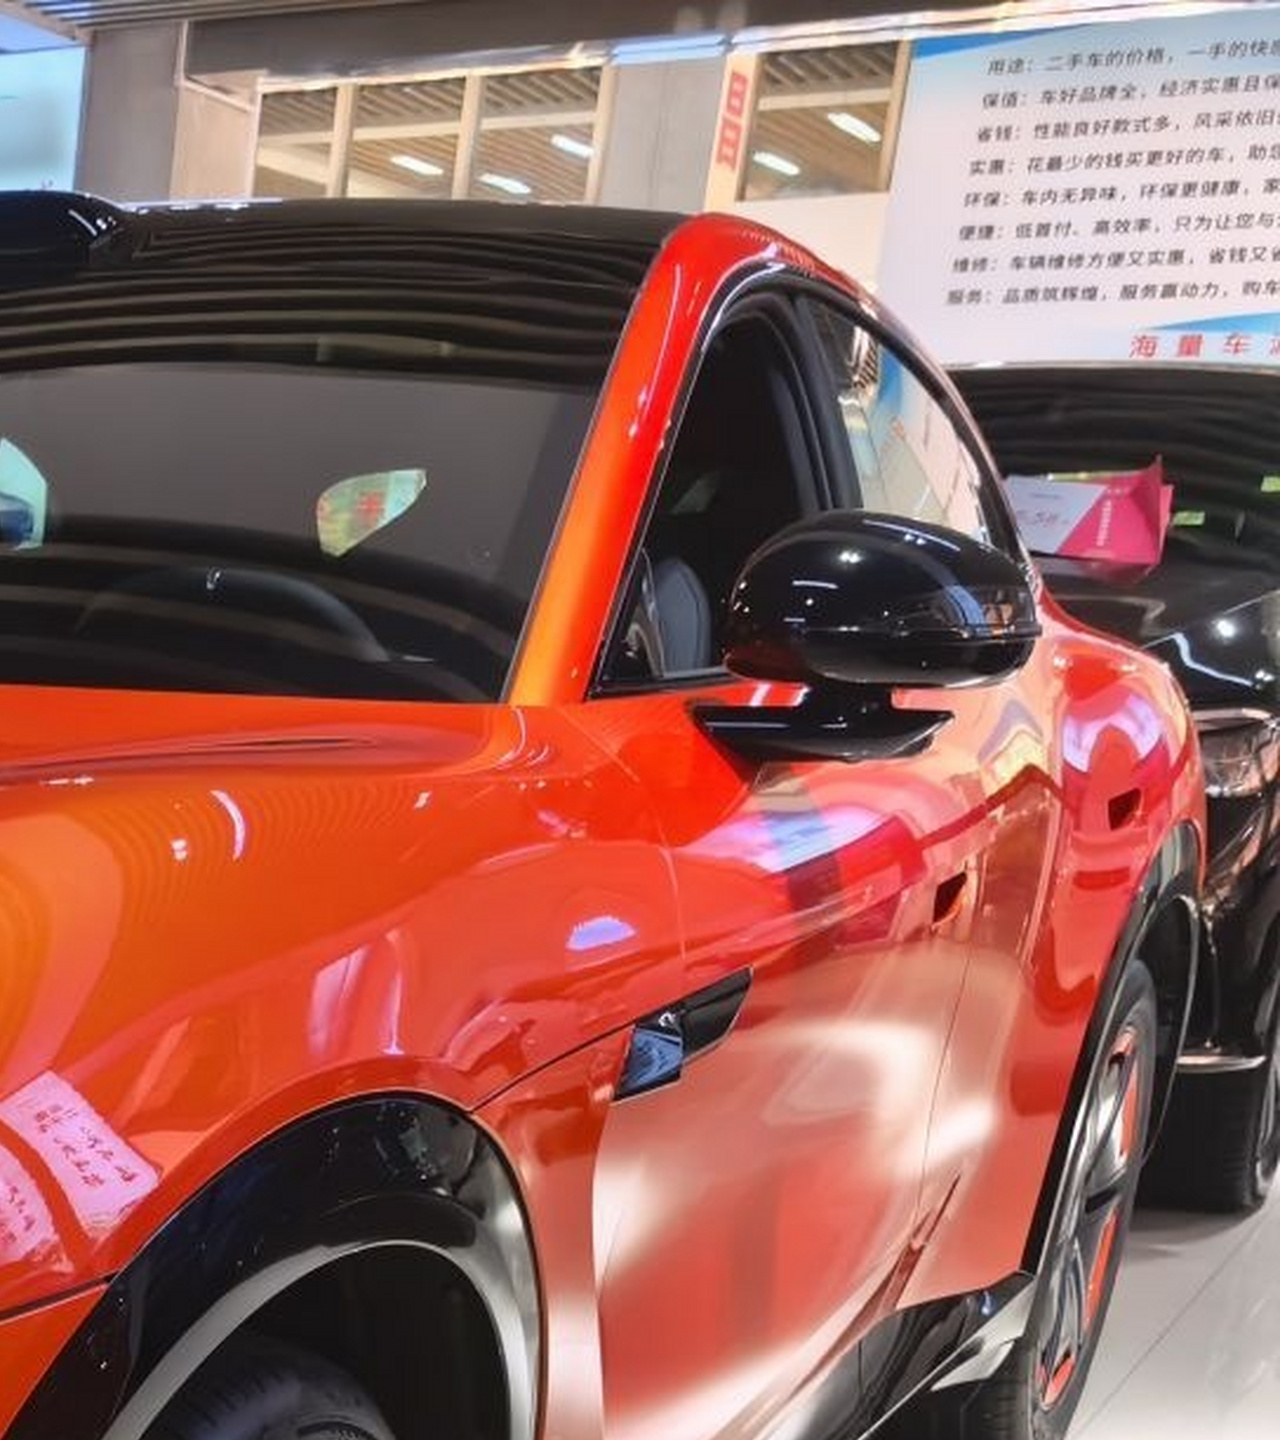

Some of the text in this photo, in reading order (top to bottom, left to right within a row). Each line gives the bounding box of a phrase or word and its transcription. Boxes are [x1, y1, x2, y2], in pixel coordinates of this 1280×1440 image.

[977, 109, 1280, 143] 省钱：性能良好款式多，风采依旧
[959, 212, 1280, 241] 便捷：低首付、高效率，只为让您与
